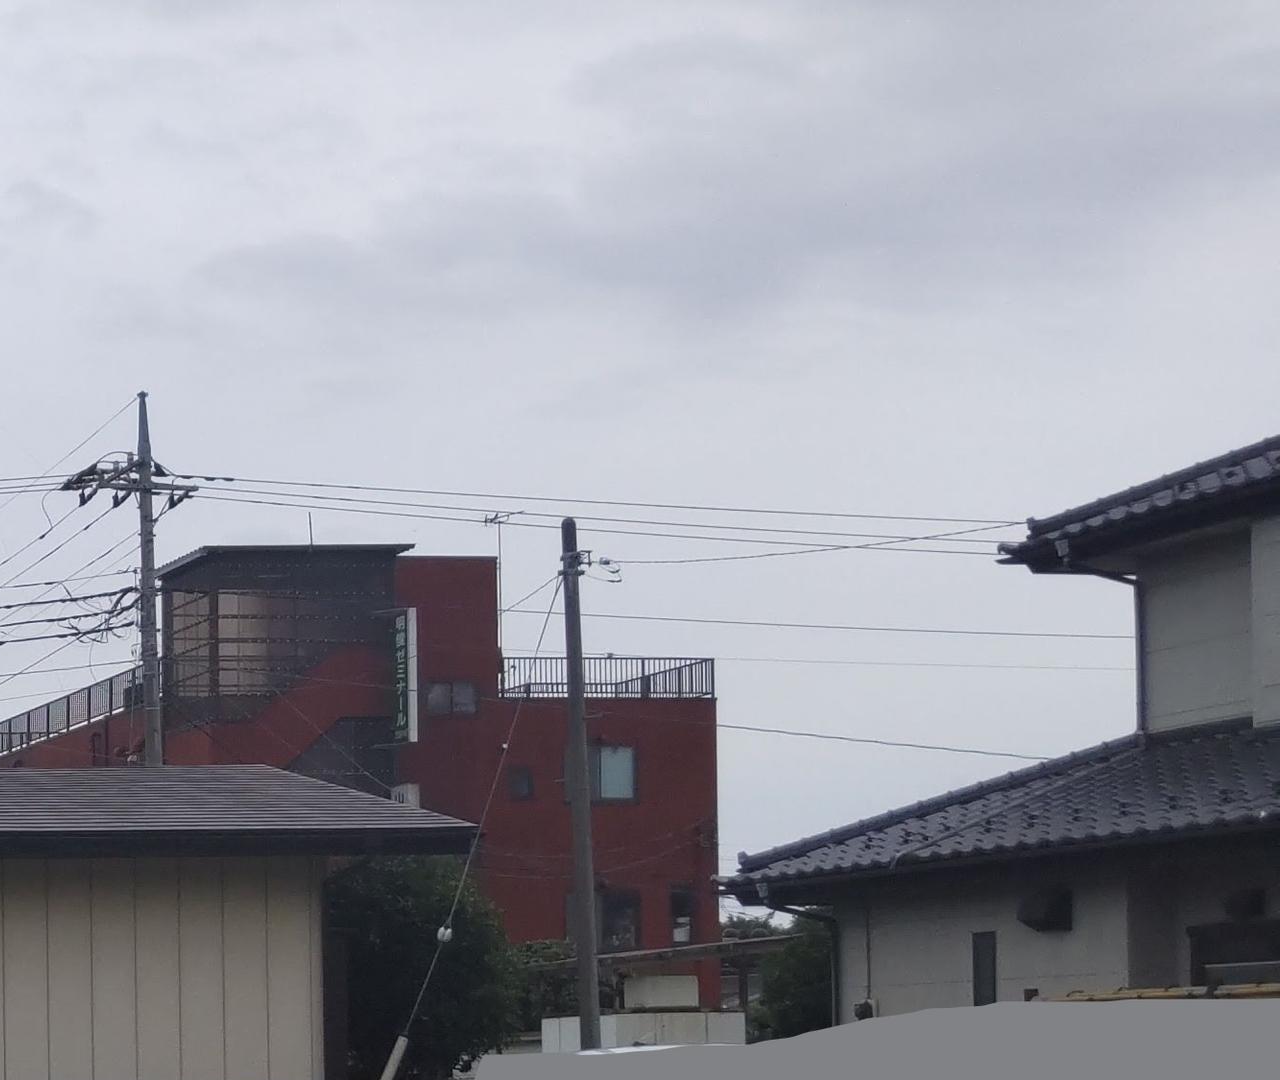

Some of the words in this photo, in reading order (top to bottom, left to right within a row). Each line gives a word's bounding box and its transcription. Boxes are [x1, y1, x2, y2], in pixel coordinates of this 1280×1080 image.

[395, 616, 407, 726] ゼミナール
